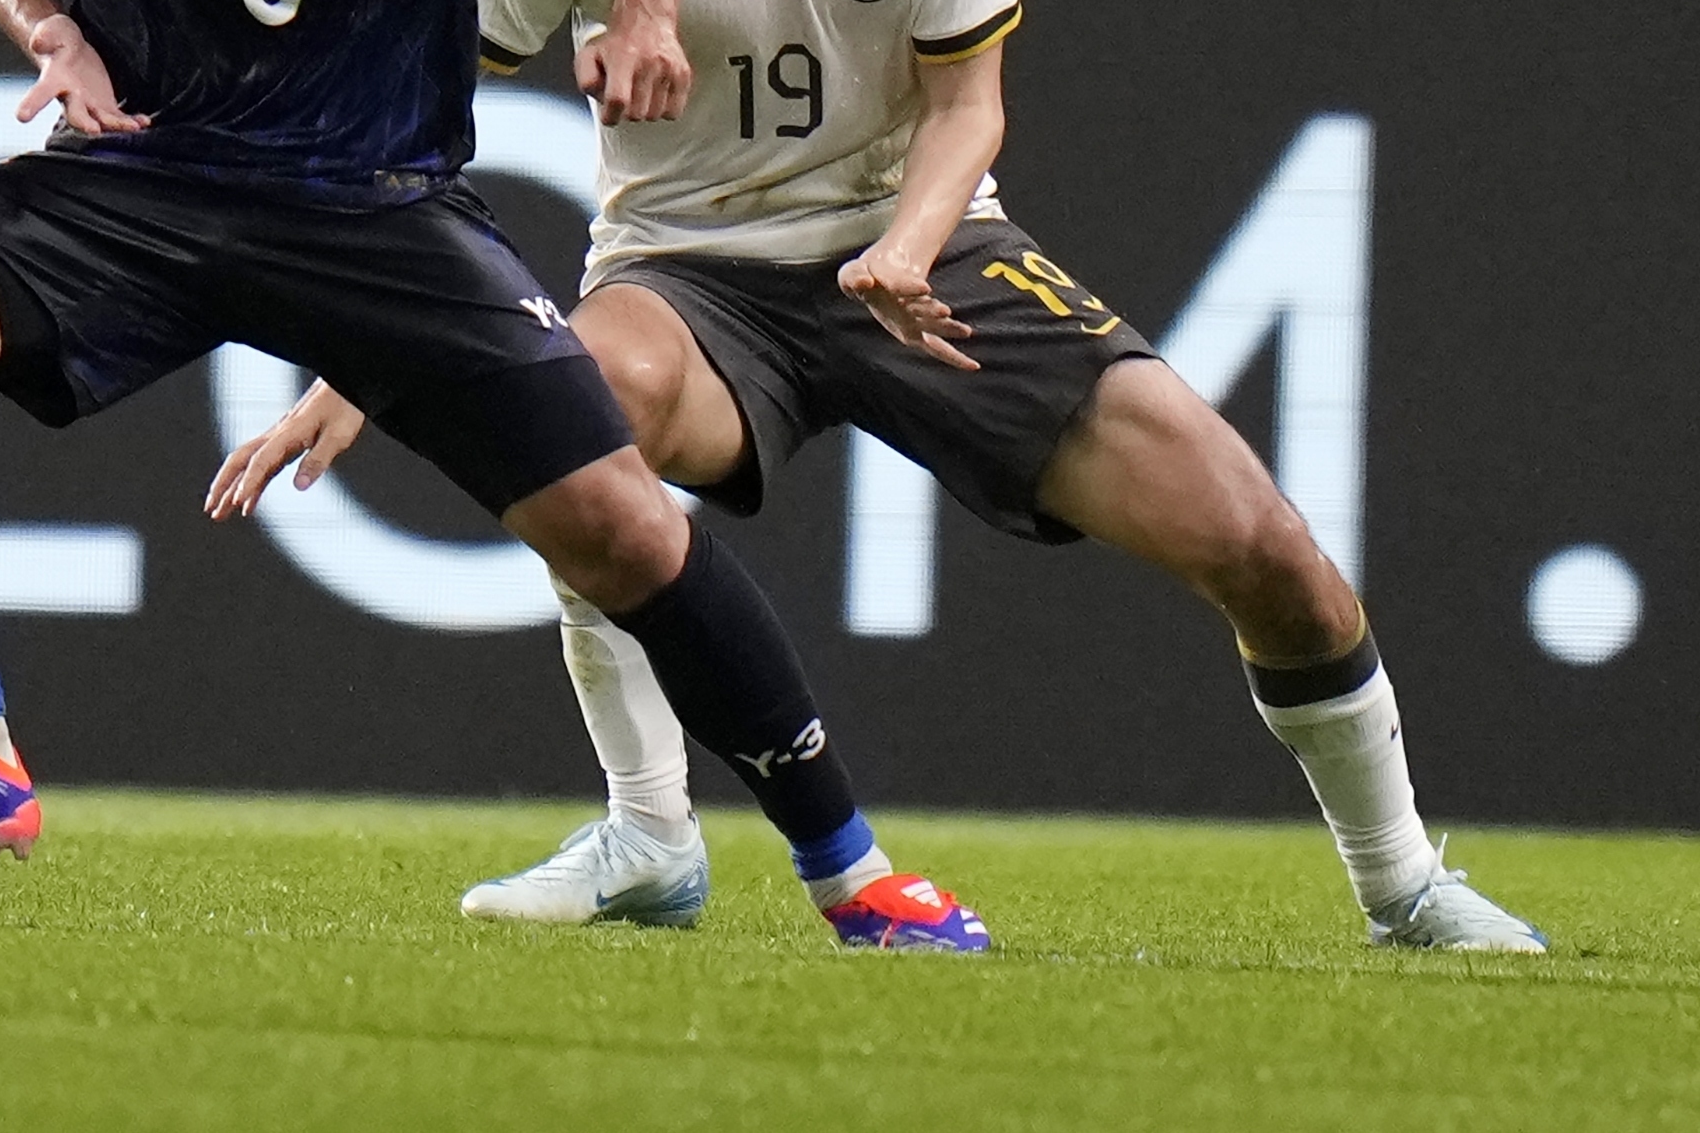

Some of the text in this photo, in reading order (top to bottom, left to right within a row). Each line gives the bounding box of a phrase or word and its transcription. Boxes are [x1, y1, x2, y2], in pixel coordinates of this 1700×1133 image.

[727, 43, 824, 140] 19
[981, 250, 1106, 317] 19
[734, 717, 827, 778] Y-3
